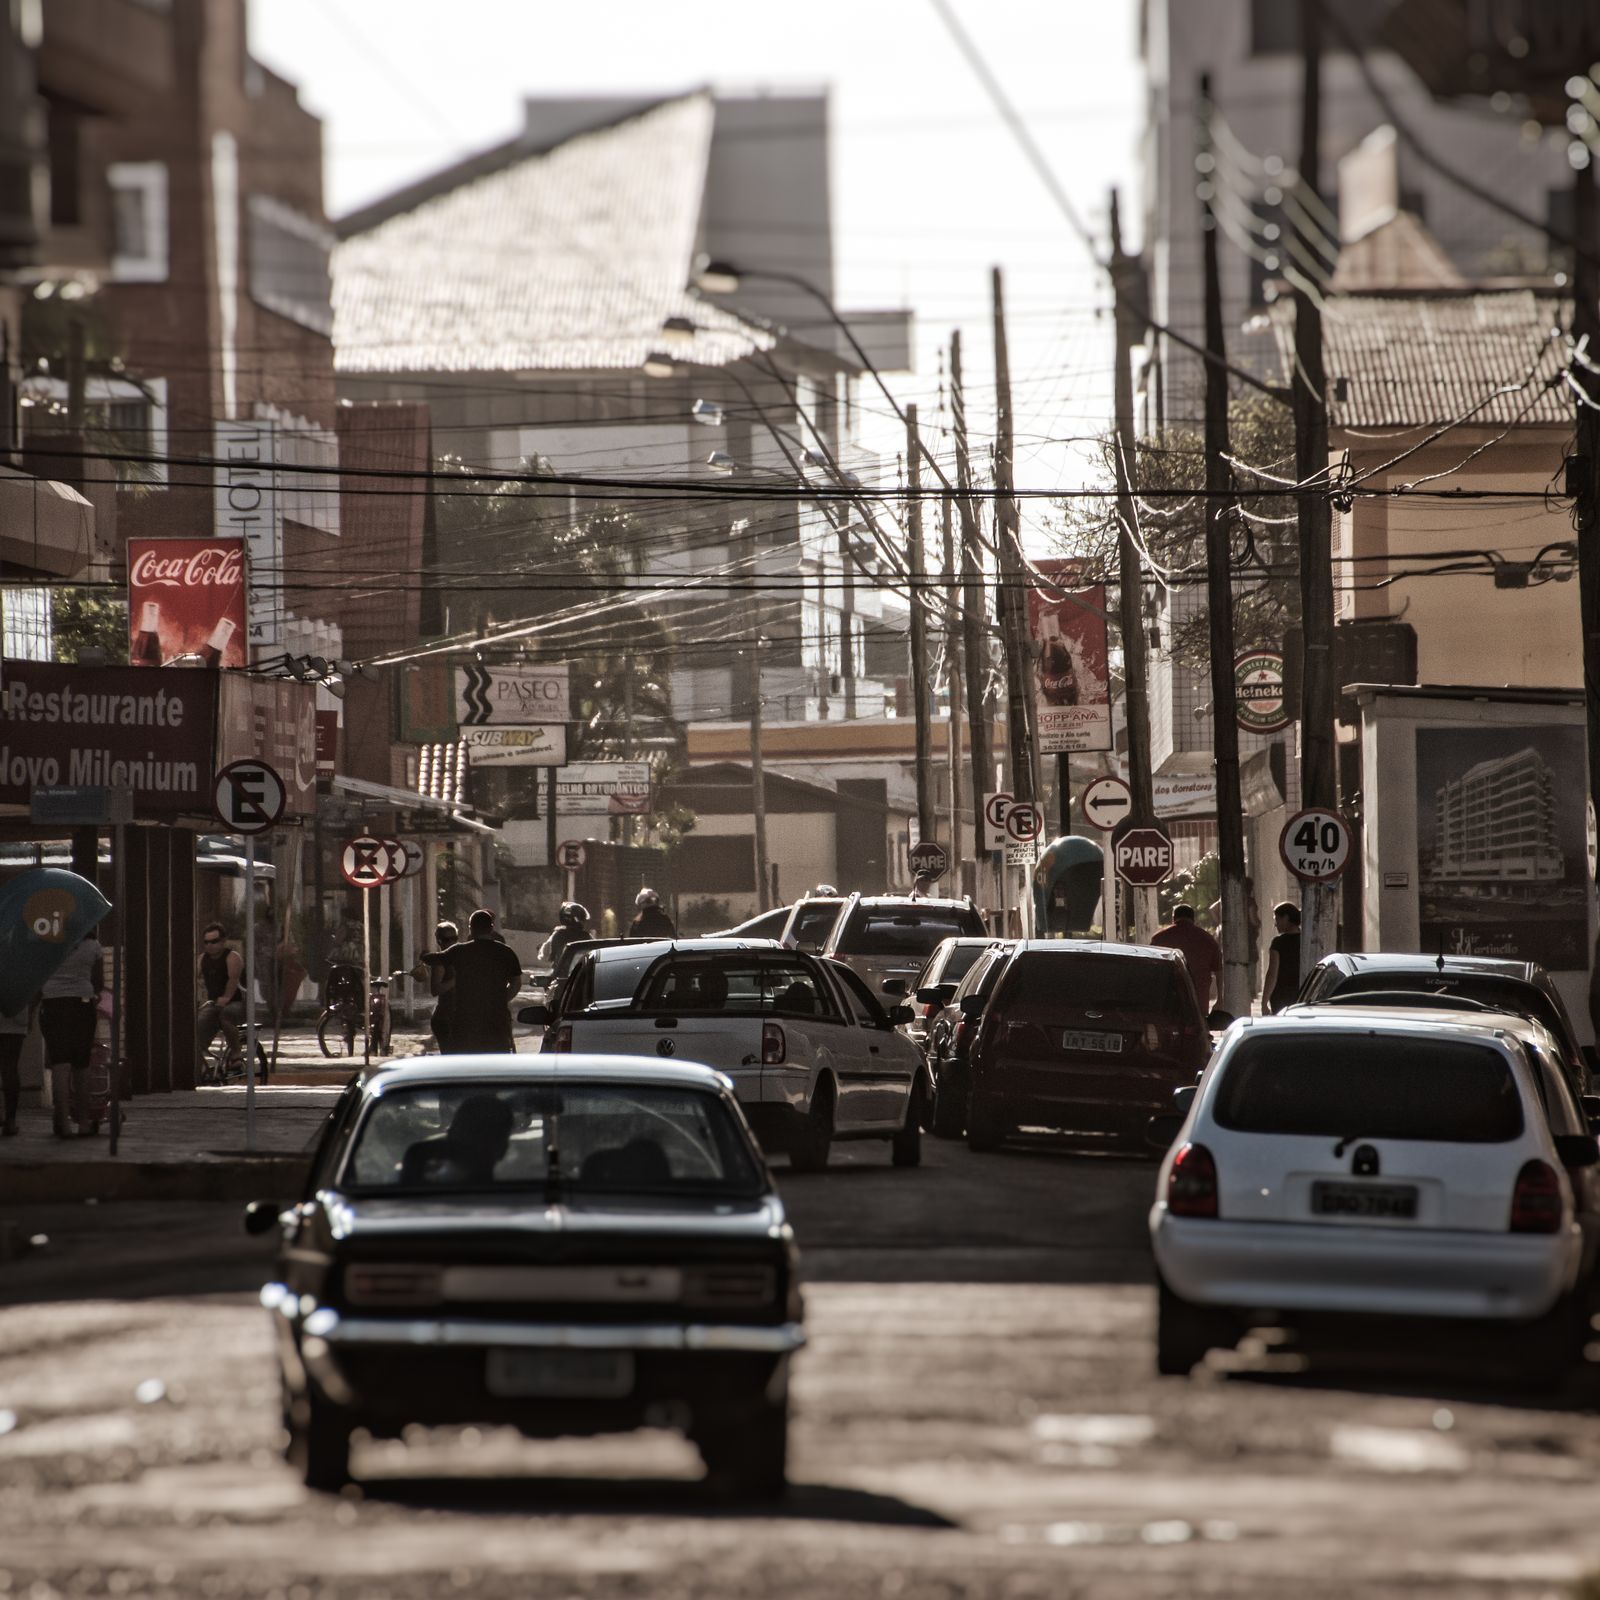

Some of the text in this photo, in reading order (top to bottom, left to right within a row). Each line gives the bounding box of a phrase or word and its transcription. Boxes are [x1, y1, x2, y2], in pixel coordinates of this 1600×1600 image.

[228, 429, 260, 538] HOTEL
[130, 549, 243, 587] Coca-Cola
[497, 680, 561, 702] PASEO
[8, 680, 184, 727] Restaurante
[468, 728, 545, 747] SUBWAY
[1293, 821, 1340, 854] 40
[911, 855, 944, 869] PARE
[1119, 846, 1169, 868] PARE
[1298, 858, 1336, 870] Km/h
[33, 911, 59, 937] oi
